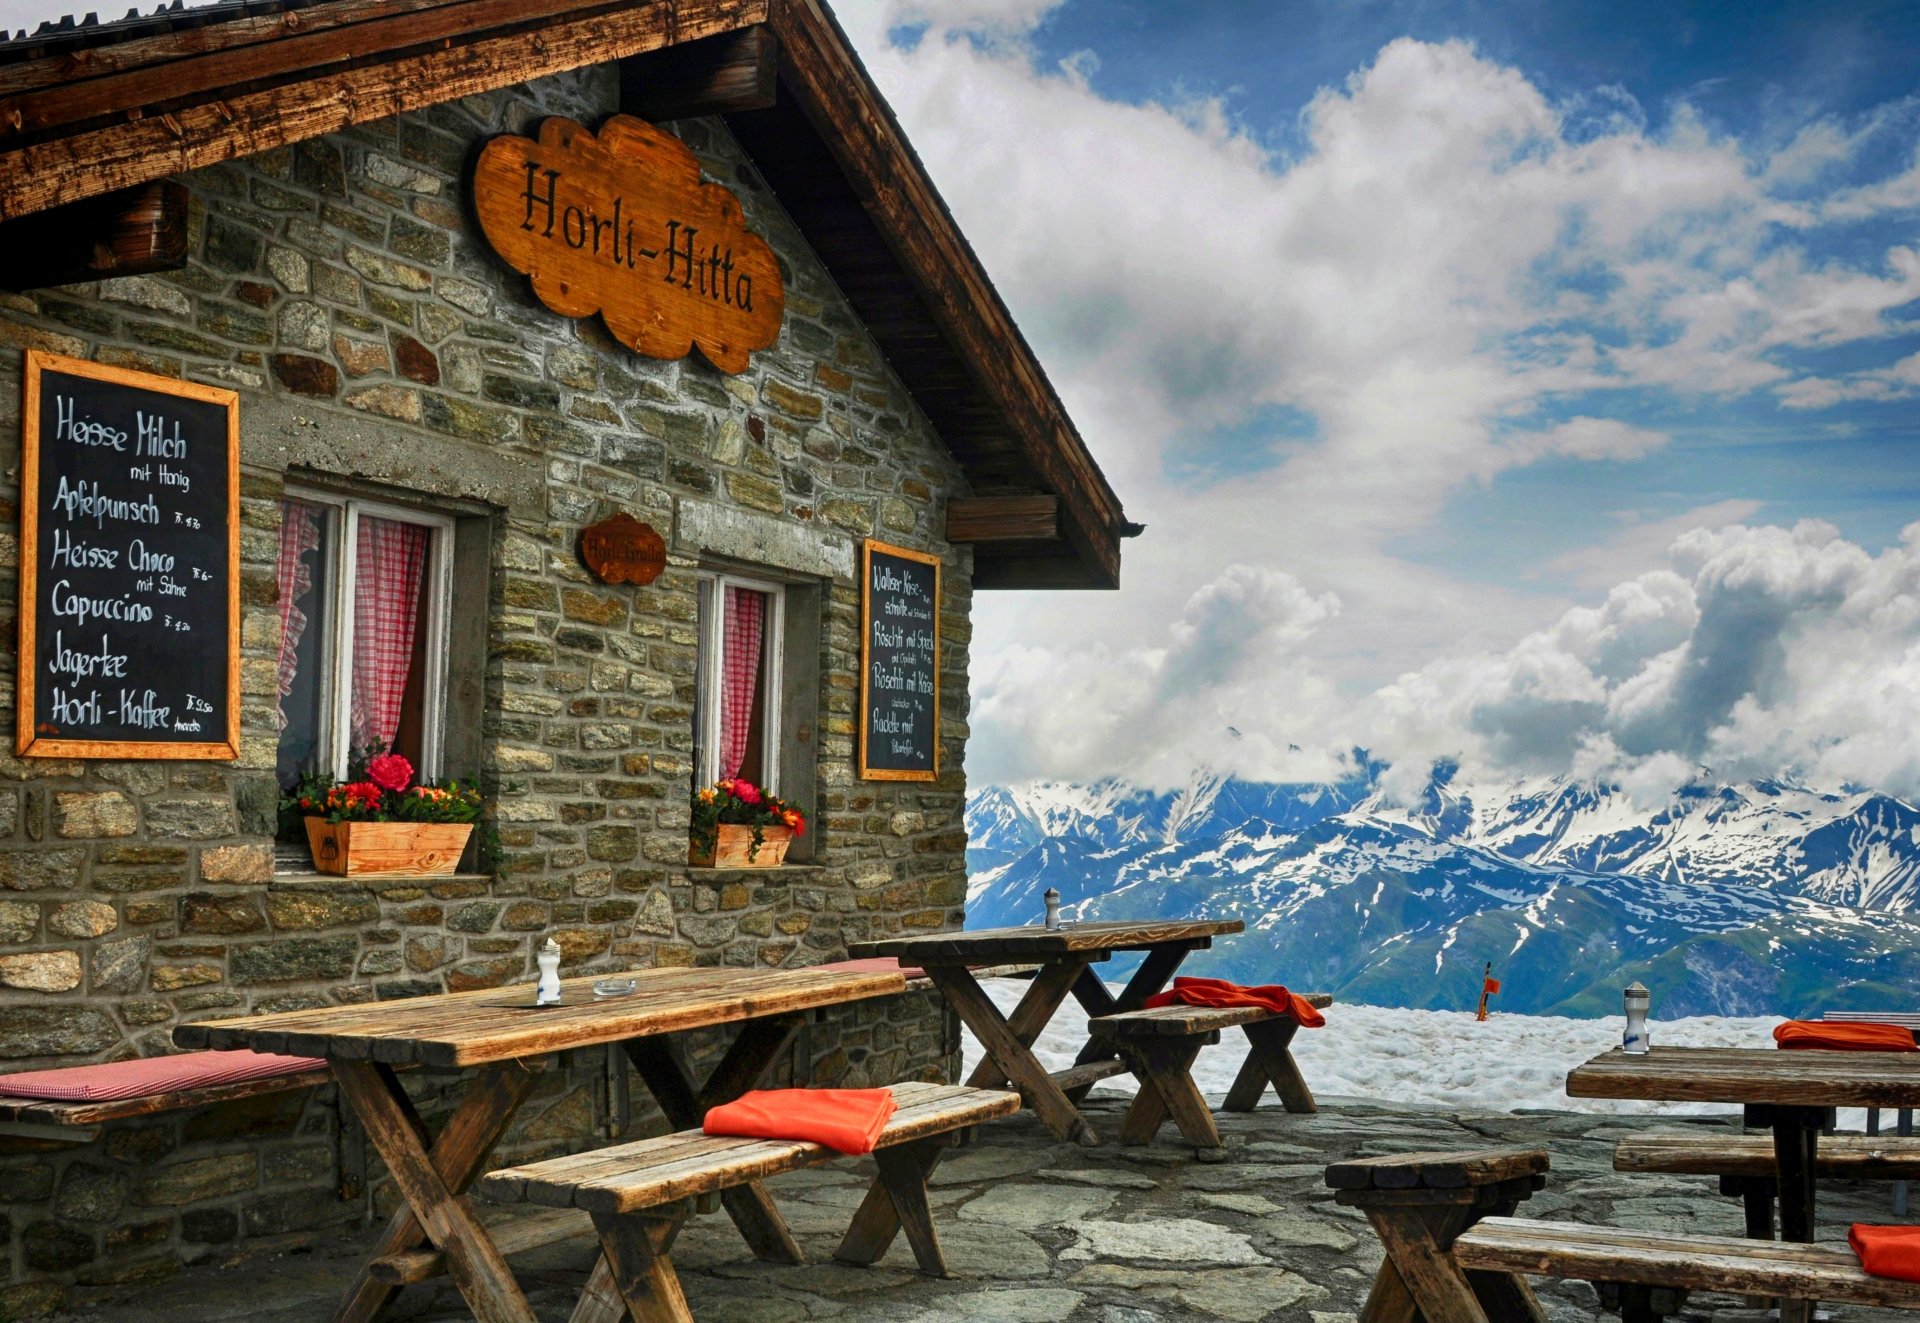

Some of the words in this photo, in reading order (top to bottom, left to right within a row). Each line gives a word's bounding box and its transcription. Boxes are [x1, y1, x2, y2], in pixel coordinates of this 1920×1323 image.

[56, 394, 128, 452] Heisse
[136, 410, 187, 459] Milch
[130, 463, 153, 482] mit
[158, 463, 190, 493] Honig
[52, 475, 160, 530] Apfelpunsch
[51, 528, 119, 570] Heisse
[129, 538, 175, 573] Choco
[136, 576, 154, 592] mit
[158, 575, 187, 598] Sahne
[52, 579, 154, 626] Capuccino
[906, 630, 916, 648] mit
[906, 671, 917, 692] mit
[902, 712, 914, 735] mit
